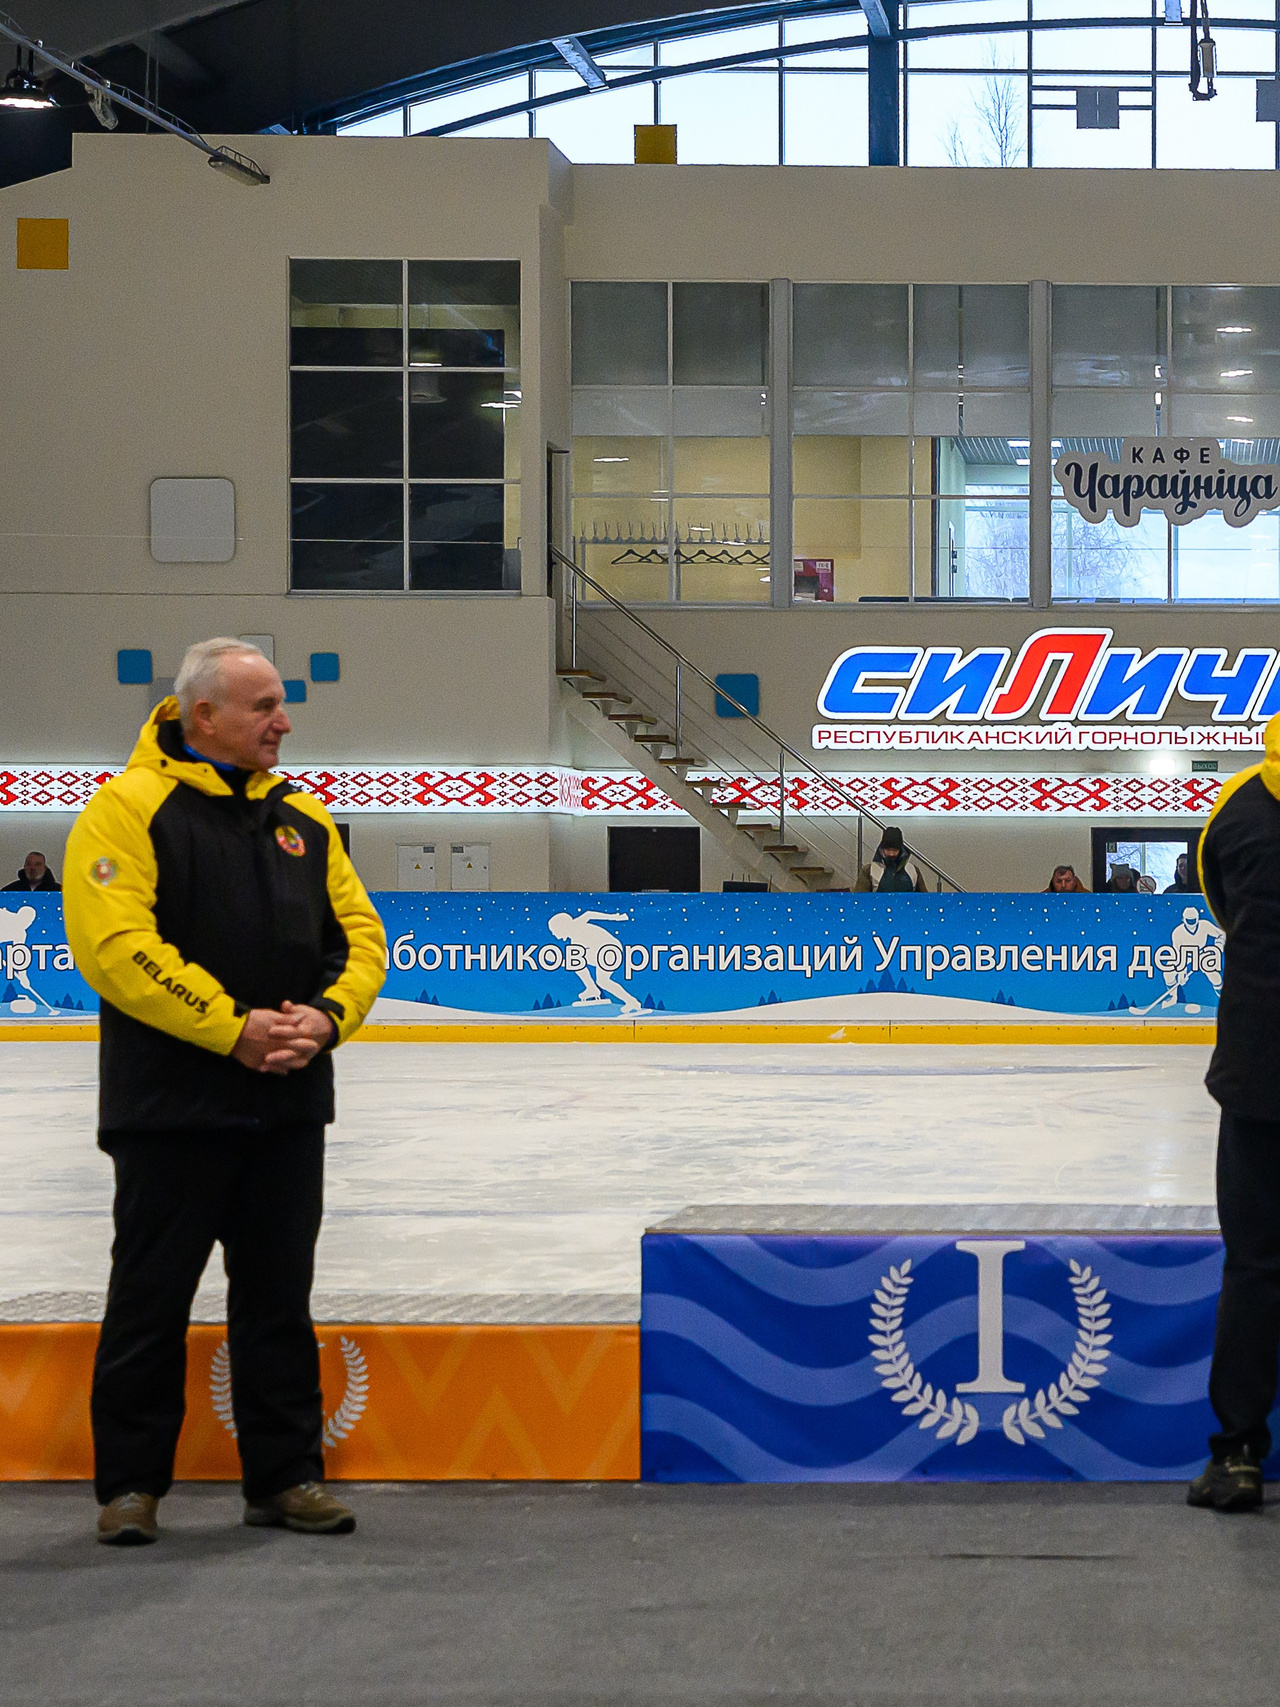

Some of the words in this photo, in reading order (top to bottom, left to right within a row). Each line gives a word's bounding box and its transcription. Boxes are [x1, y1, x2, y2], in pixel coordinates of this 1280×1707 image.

[1131, 446, 1211, 465] КАФЕ
[1064, 461, 1279, 518] Чараўніца
[816, 728, 1071, 746] РЕСПУБЛИКАНСКИЙ
[1079, 730, 1265, 746] ГОРНОЛЫЖНЫ
[0, 943, 75, 980] рта
[384, 933, 587, 972] ботников
[597, 937, 863, 979] организаций
[873, 936, 1118, 979] Управления
[132, 951, 210, 1014] BELARUS
